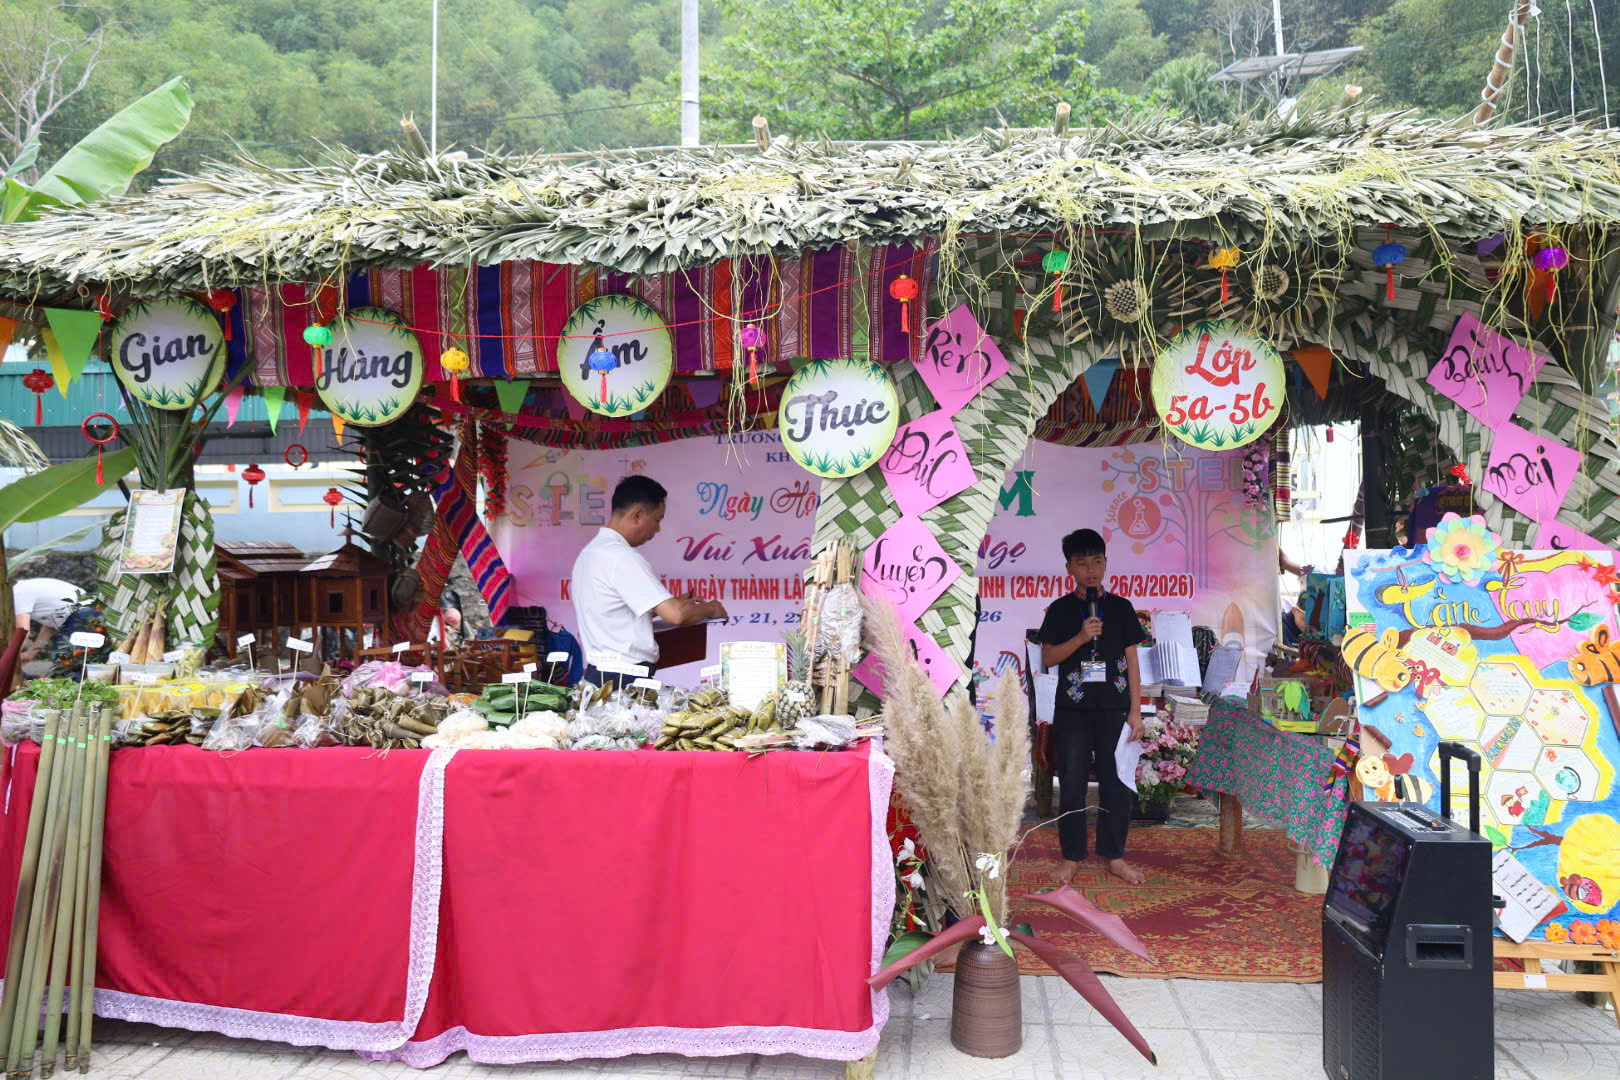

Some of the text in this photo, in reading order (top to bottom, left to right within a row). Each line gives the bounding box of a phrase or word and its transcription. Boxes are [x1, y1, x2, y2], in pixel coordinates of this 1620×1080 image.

[119, 332, 214, 383] Gian
[316, 349, 413, 391] Hàng
[1185, 332, 1257, 387] Lớp
[784, 390, 890, 443] Thực
[697, 482, 764, 521] Ngày
[676, 532, 734, 562] Vui
[742, 534, 813, 565] Xuâ
[730, 573, 780, 601] THÀNH
[1109, 574, 1195, 600] 26/3/2026)
[749, 612, 777, 625] 21,
